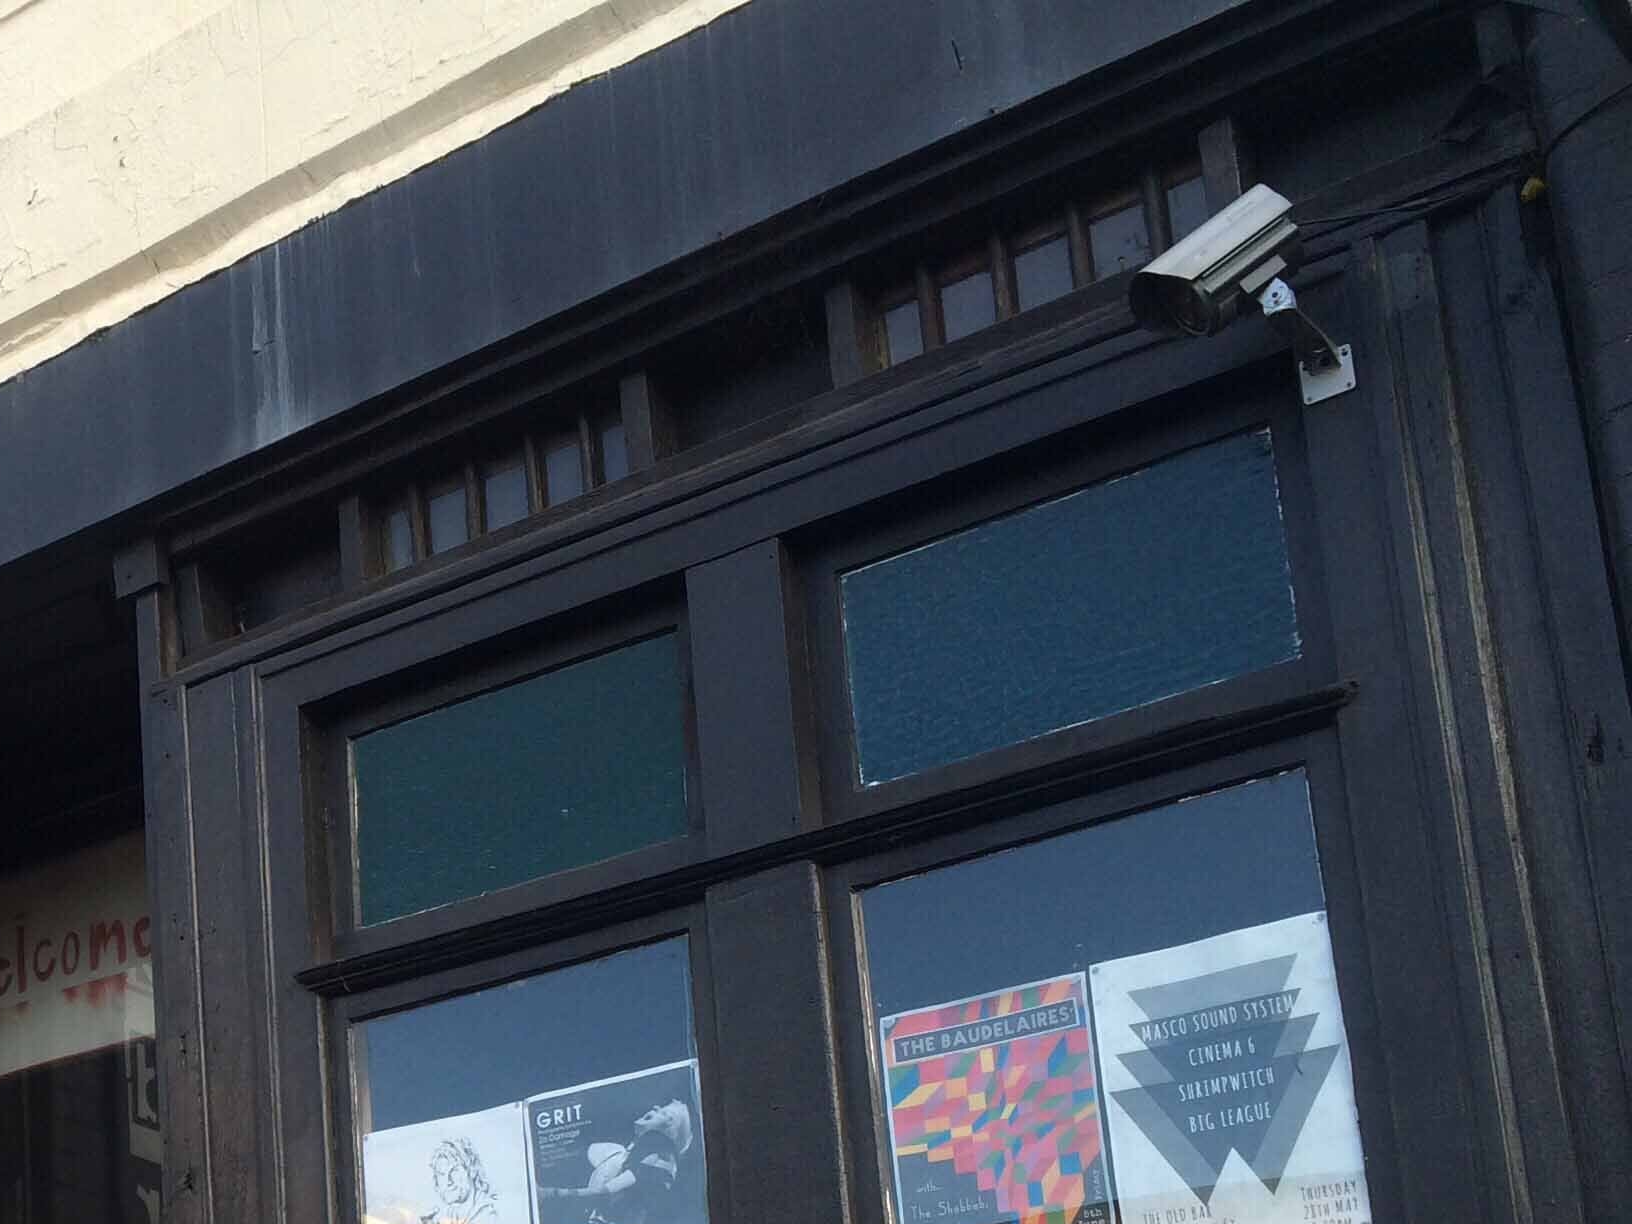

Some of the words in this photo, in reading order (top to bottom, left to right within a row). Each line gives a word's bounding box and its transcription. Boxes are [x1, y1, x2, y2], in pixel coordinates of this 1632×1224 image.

[1192, 1006, 1238, 1032] SOUND
[1243, 993, 1295, 1020] SYSTEM
[901, 1036, 936, 1058] THE
[1188, 1040, 1243, 1066] CINEMA
[1178, 1065, 1275, 1102] SHRIMPWITCH
[536, 1103, 582, 1128] GRIT
[1188, 1112, 1215, 1134] BIG
[1220, 1101, 1272, 1128] LEAGUE
[1299, 1180, 1358, 1202] THURSDAY
